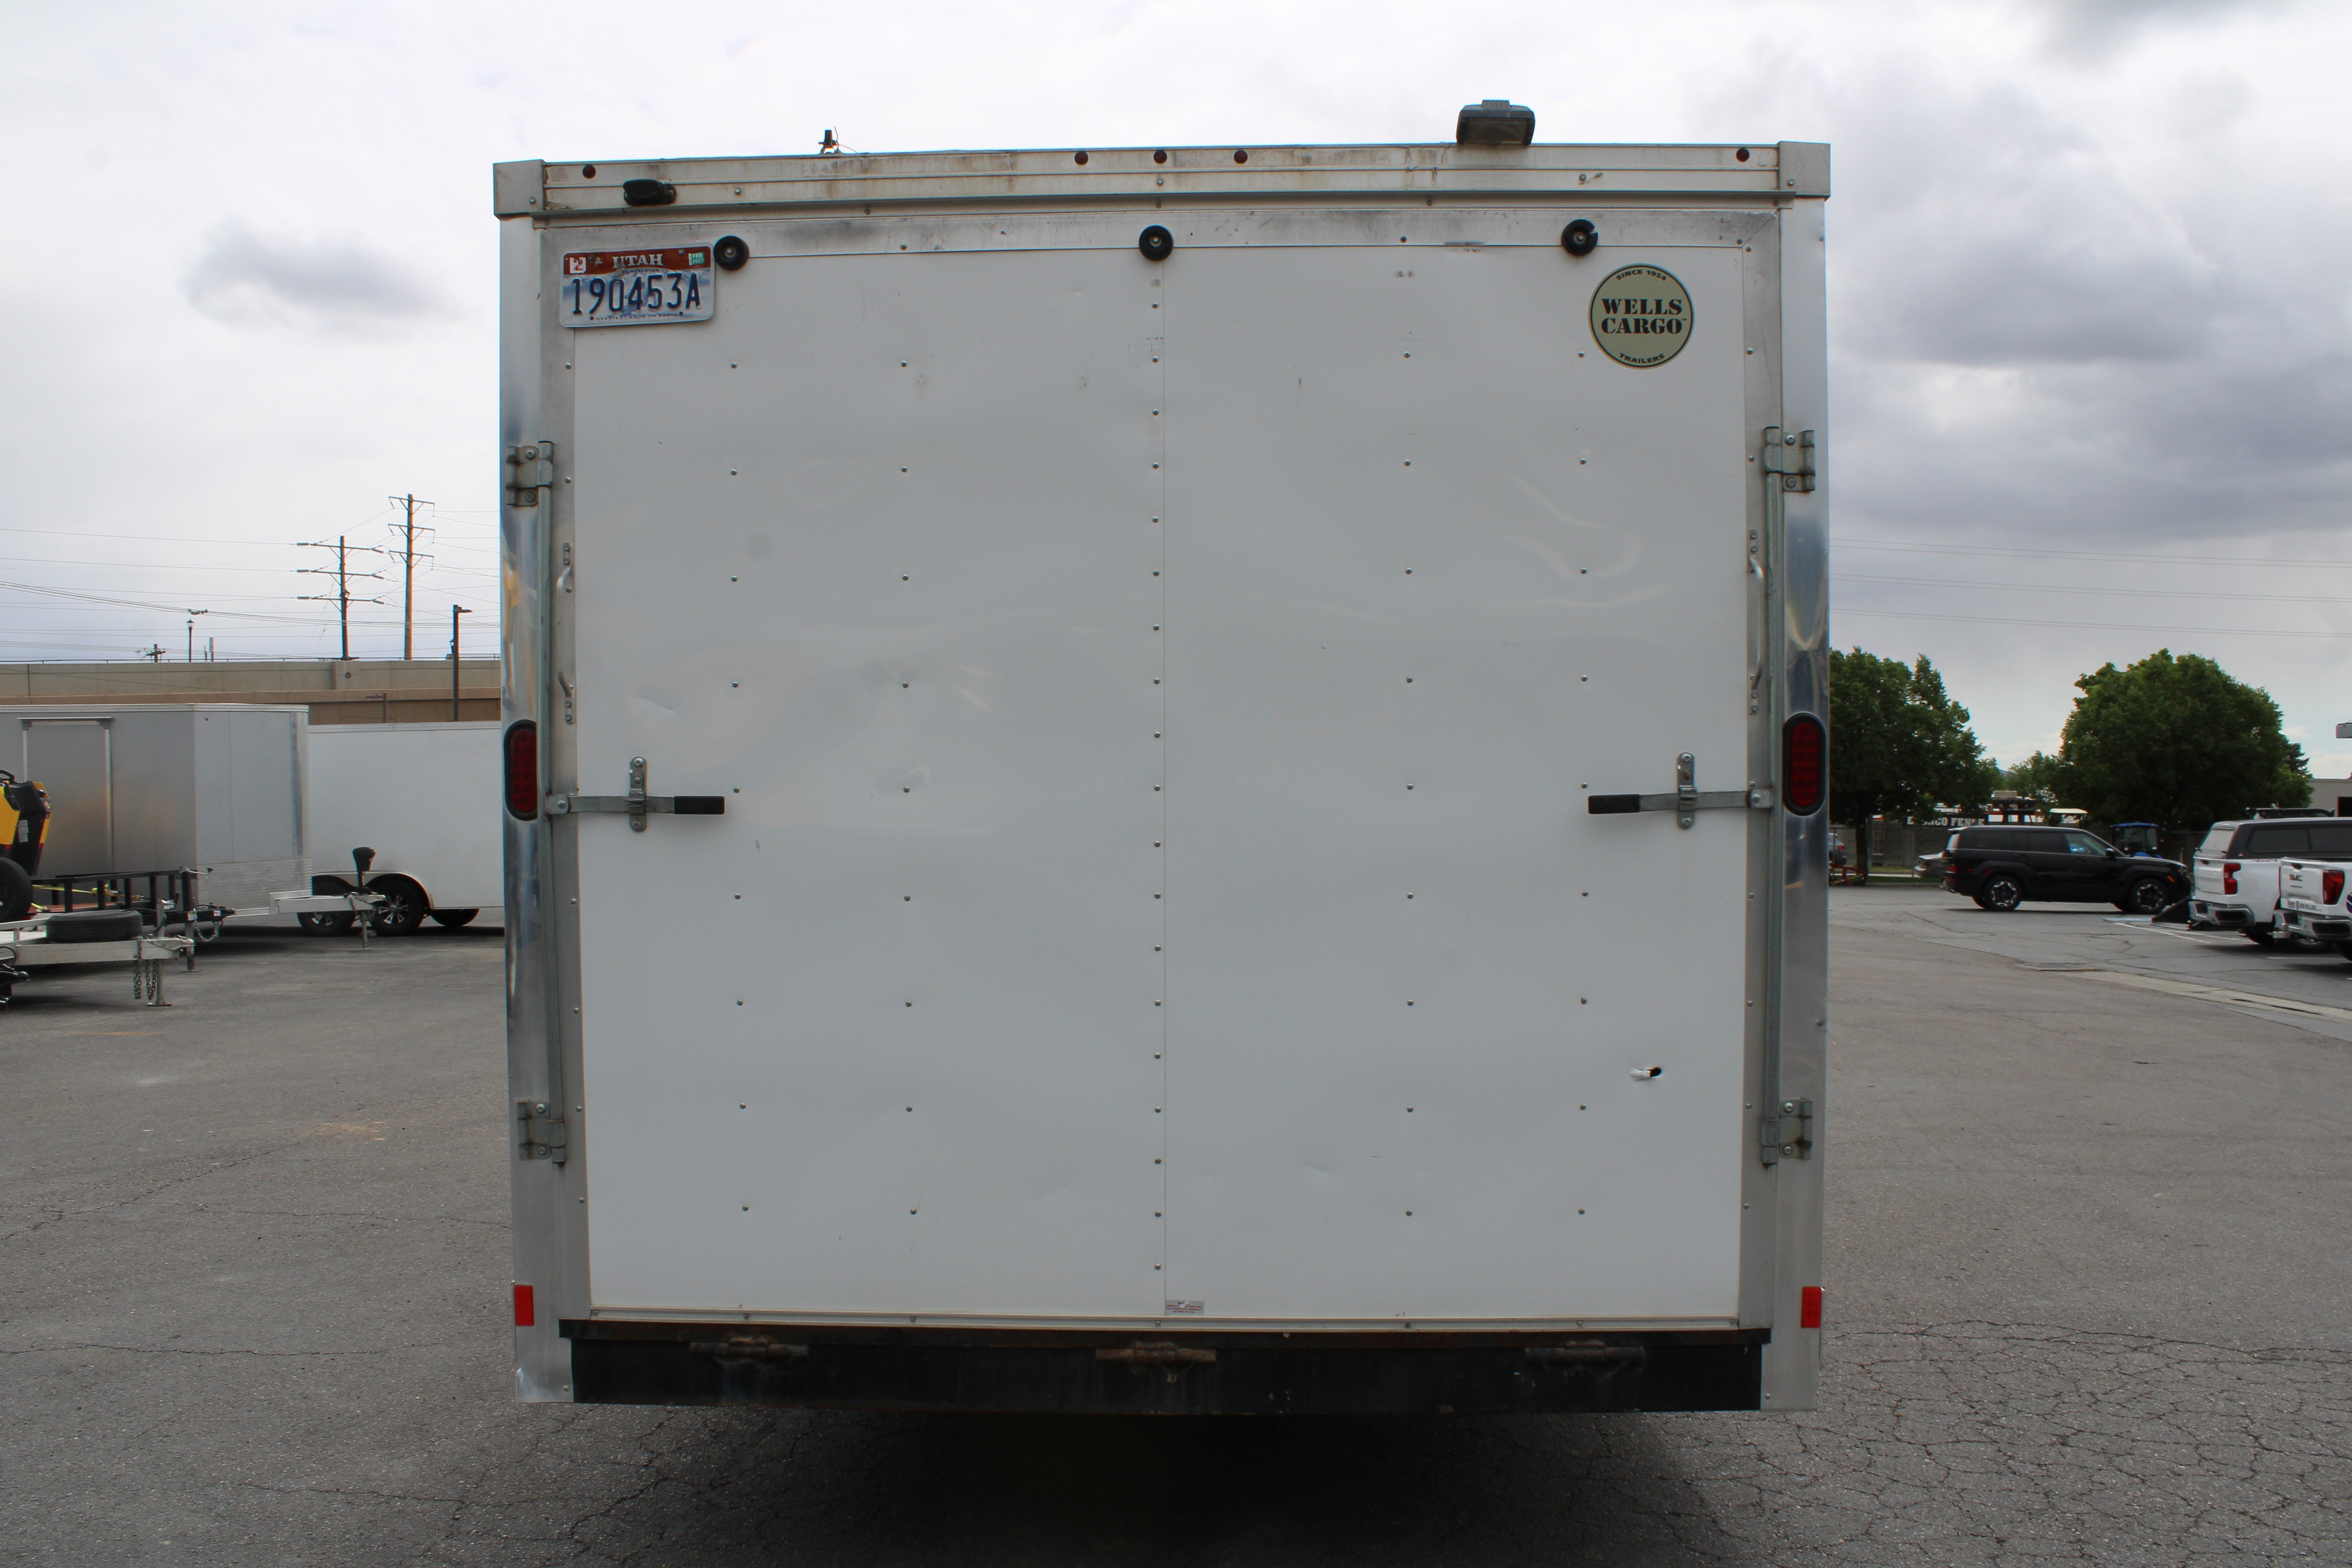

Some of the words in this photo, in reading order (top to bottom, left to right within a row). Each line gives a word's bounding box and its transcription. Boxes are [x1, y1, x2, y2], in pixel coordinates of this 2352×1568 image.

[612, 254, 663, 268] UTAH
[1616, 269, 1643, 281] SINCE
[1646, 270, 1667, 281] 1954
[572, 272, 701, 314] 190453A
[1601, 298, 1682, 315] WELLS
[1601, 317, 1682, 334] CARGO
[1619, 352, 1665, 363] TRAILERS
